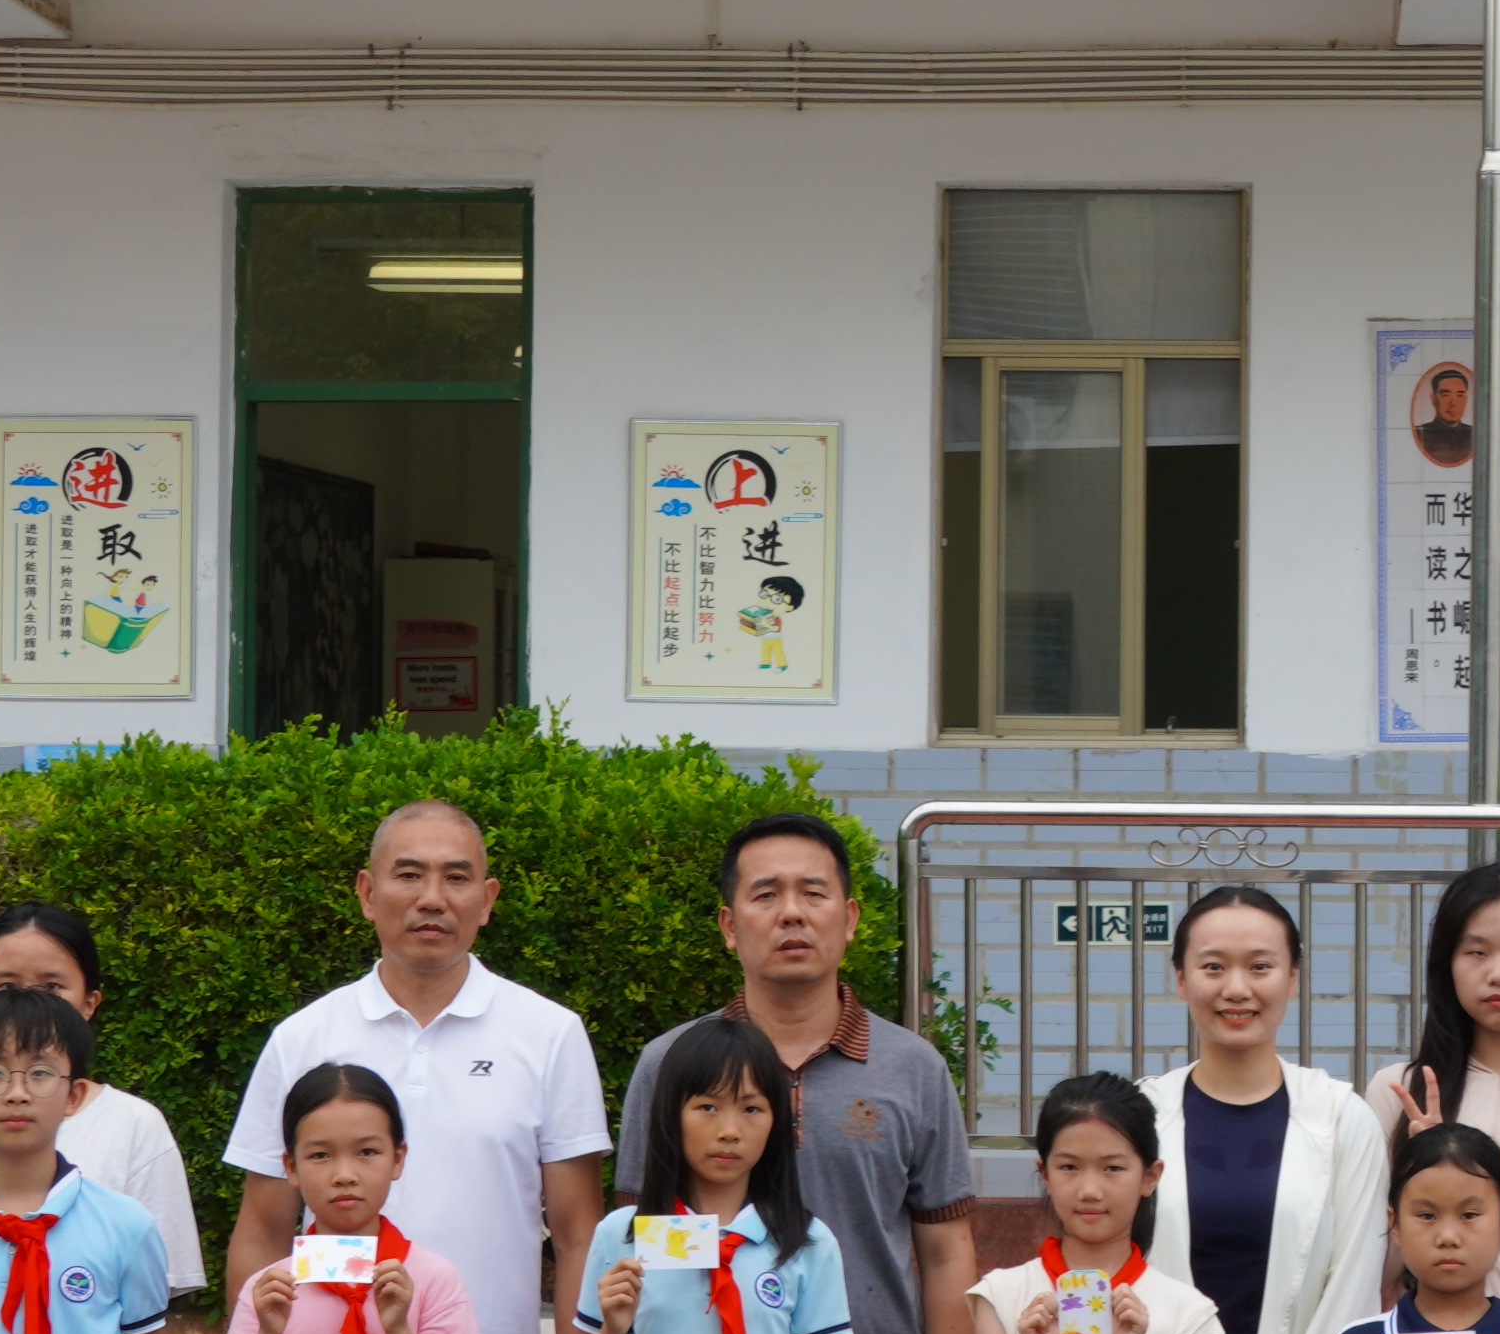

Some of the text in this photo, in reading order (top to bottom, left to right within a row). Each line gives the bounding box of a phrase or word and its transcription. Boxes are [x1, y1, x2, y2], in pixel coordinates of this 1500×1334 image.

[69, 450, 130, 510] 进
[713, 458, 769, 510] 上
[59, 514, 75, 641] 进取是一种向上的精神
[97, 524, 143, 567] 取
[698, 526, 717, 644] 不比智力比努力
[741, 520, 790, 567] 进
[23, 522, 38, 662] 进取才能获得人生的辉煌
[662, 542, 682, 658] 不比起点比起步
